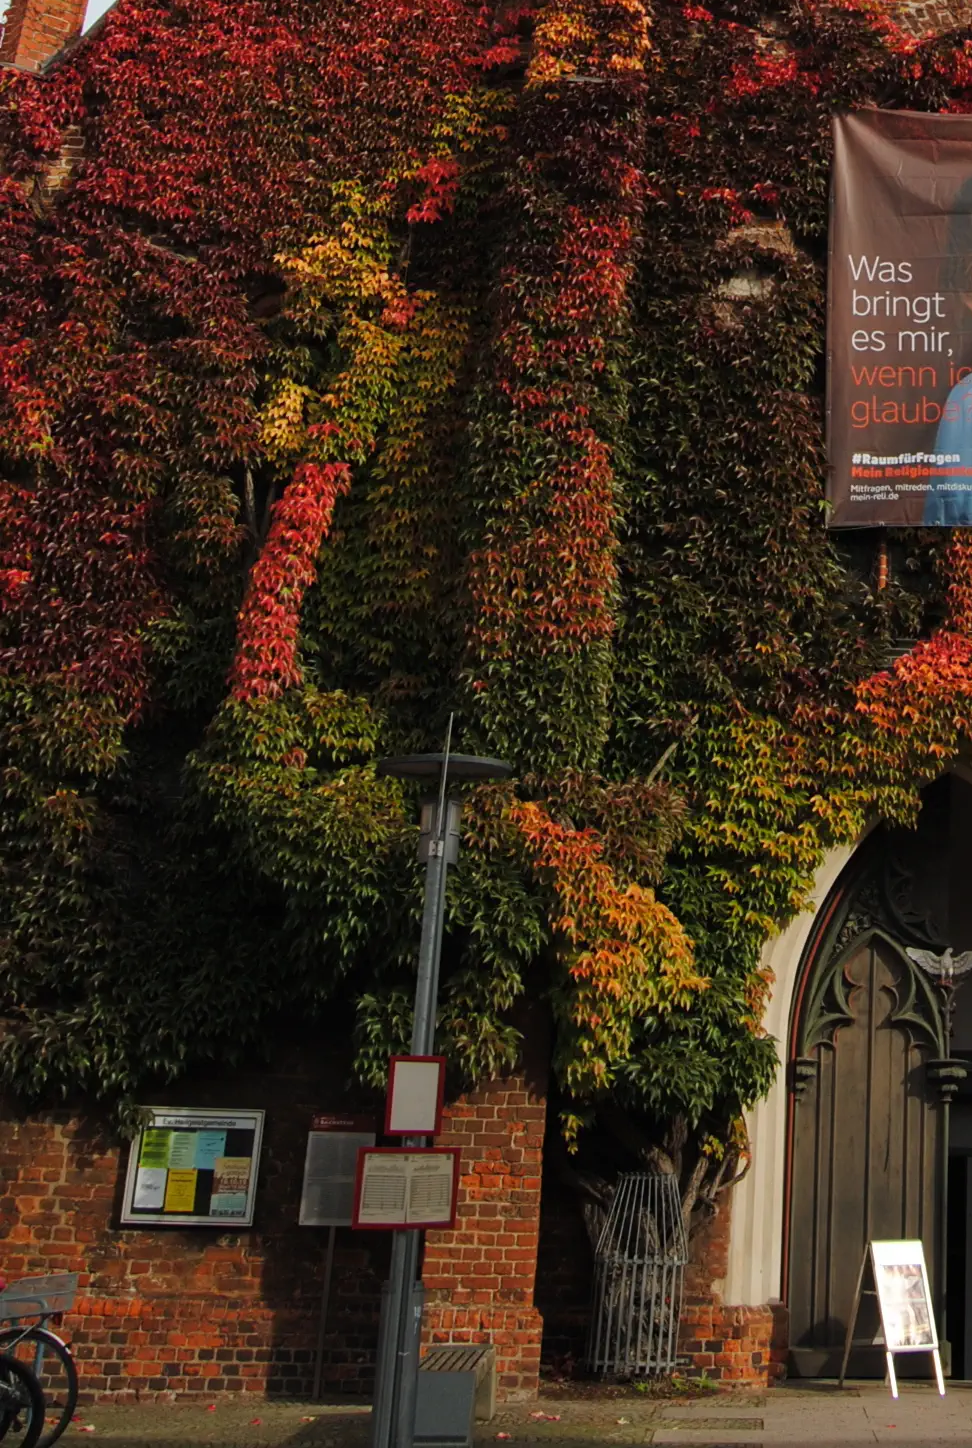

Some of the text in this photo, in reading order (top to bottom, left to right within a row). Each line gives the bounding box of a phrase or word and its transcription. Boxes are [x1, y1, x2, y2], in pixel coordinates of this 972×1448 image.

[848, 254, 913, 283] Was
[852, 289, 946, 323] bringt
[851, 326, 954, 357] es mir,
[851, 364, 937, 388] wenn
[852, 452, 961, 466] #RaumfürFragen
[852, 466, 883, 478] Mein
[850, 483, 893, 494] Mitfragen,
[895, 483, 935, 492] mitreden,
[850, 492, 899, 502] mein-reli.de
